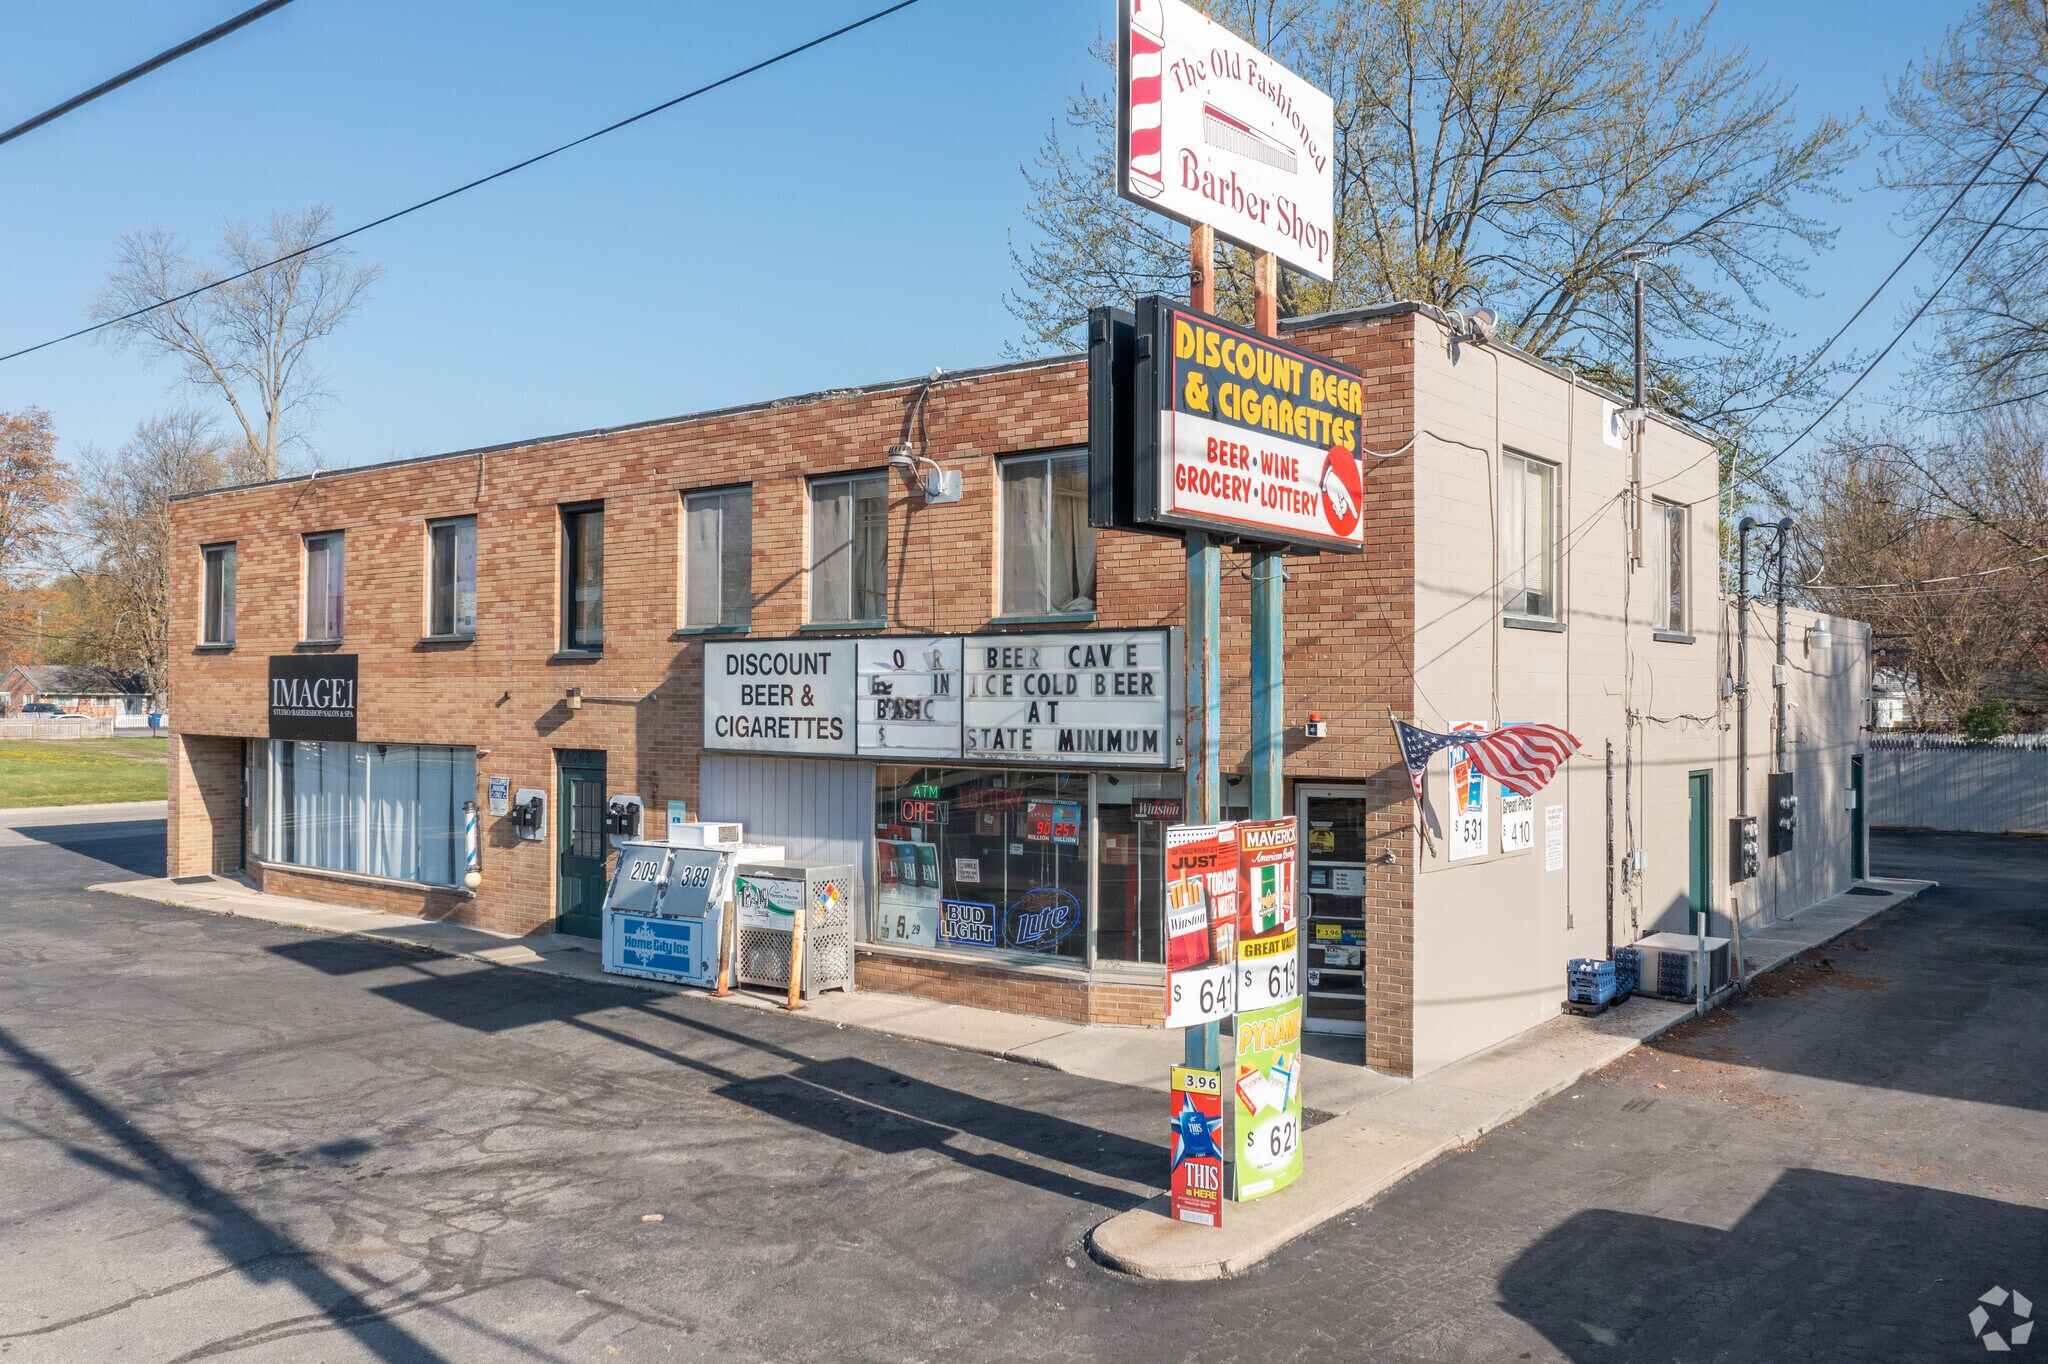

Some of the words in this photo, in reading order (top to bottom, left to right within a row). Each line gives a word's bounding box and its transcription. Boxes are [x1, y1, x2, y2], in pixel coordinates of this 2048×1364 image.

[1170, 57, 1206, 94] The
[1210, 48, 1242, 81] Old
[1246, 58, 1327, 175] Fashioned
[1178, 147, 1271, 224] Barber
[1276, 195, 1329, 263] Shop
[1175, 320, 1304, 395] DISCOUNT
[1310, 368, 1362, 415] BEER
[1184, 370, 1210, 413] &
[1218, 382, 1356, 452] CIGARETTES
[1207, 436, 1250, 470] BEER
[1260, 450, 1299, 483] WINE
[1175, 463, 1252, 504] GROCERY
[1260, 481, 1318, 517] LOTTERY
[726, 652, 831, 676] DISCOUNT
[986, 647, 1040, 669] BEER
[271, 677, 355, 709] IMAGE1
[934, 673, 949, 694] IN
[969, 674, 1013, 696] ICE
[1024, 673, 1077, 696] COLD
[1094, 672, 1154, 695] BEER
[741, 684, 794, 706] BEER
[801, 683, 814, 707] &
[1027, 701, 1059, 723] AT
[715, 715, 843, 740] CIGARETTES
[967, 728, 1032, 750] STATE
[1058, 729, 1158, 752] MINIMUM
[913, 784, 938, 799] ATM
[959, 787, 1024, 812] LOTTERY
[902, 801, 946, 823] OPEN
[1139, 802, 1180, 815] Winston
[1503, 797, 1517, 814] Great
[1518, 796, 1532, 812] Price
[1036, 821, 1051, 835] 90
[1054, 823, 1077, 836] 257
[1246, 826, 1296, 848] MAVERICK
[1455, 820, 1458, 832] $
[964, 862, 977, 870] SMILE
[1171, 855, 1217, 870] JUST
[1252, 850, 1283, 863] American
[681, 867, 710, 888] 3.89
[777, 899, 800, 907] EXPRESS
[947, 904, 985, 924] BUD
[1211, 898, 1217, 919] &
[940, 919, 993, 942] LIGHT
[1016, 905, 1069, 944] Lite
[1170, 913, 1205, 932] Winston
[625, 935, 652, 950] Home
[653, 939, 672, 955] City
[673, 942, 688, 955] Ice
[1244, 940, 1279, 958] GREAT
[1281, 932, 1297, 951] VALUE
[1244, 969, 1252, 989] $
[1268, 958, 1296, 998] 6.13
[1173, 983, 1182, 1004] $
[1199, 972, 1232, 1014] 6.41
[1186, 1075, 1217, 1090] 3.96
[1187, 1123, 1202, 1134] THIS
[1247, 1130, 1254, 1148] $
[1270, 1116, 1297, 1158] 6.21
[1184, 1161, 1219, 1192] THIS
[1193, 1188, 1218, 1200] HERE
